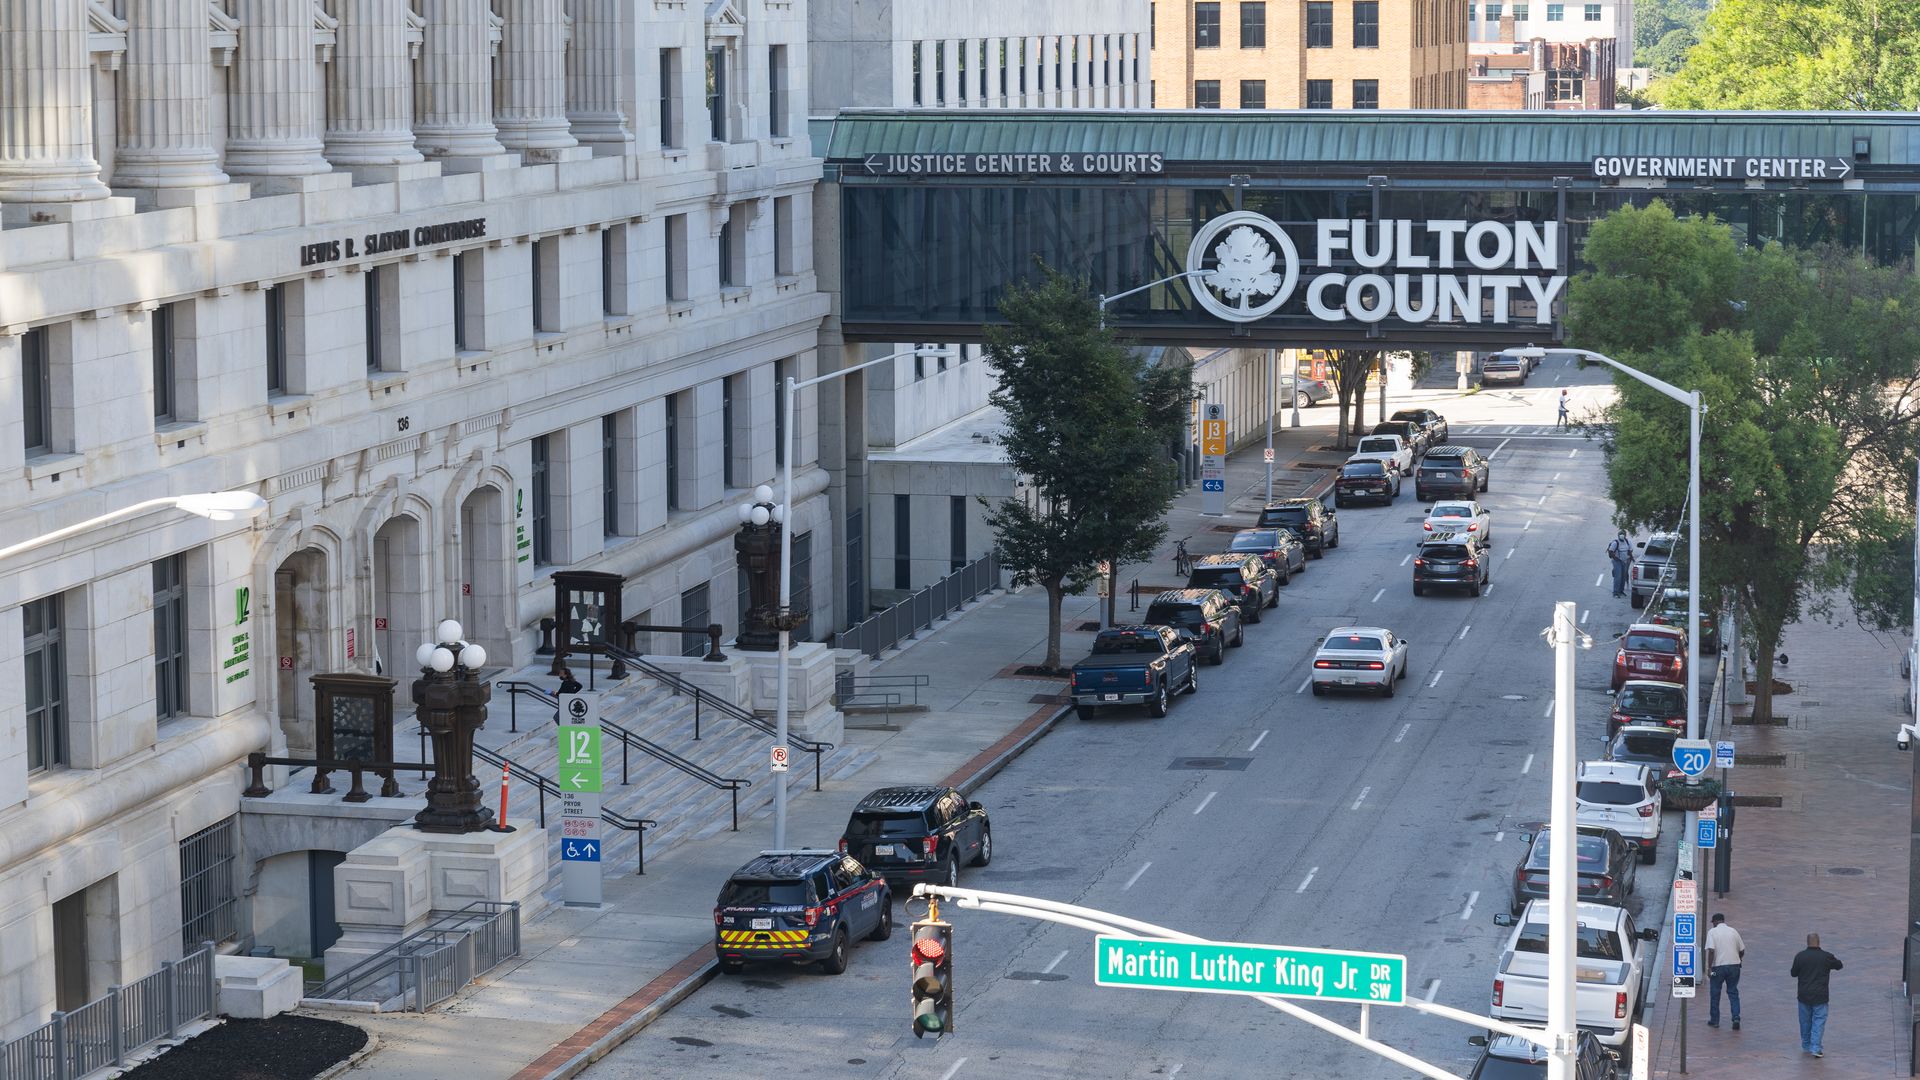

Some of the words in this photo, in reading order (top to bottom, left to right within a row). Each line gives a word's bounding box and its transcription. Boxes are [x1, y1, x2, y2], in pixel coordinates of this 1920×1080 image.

[887, 154, 967, 173] JUSTICE
[975, 154, 1051, 173] CENTER
[1059, 154, 1075, 173] &
[1082, 154, 1163, 173] COURTS
[1594, 157, 1736, 177] GOVERNMENT
[1745, 158, 1826, 177] CENTER
[300, 240, 340, 266] LEWIS
[364, 229, 410, 255] SLATON
[414, 217, 487, 247] COURTHOUSE
[1316, 218, 1558, 270] FULTON
[1306, 272, 1568, 325] COUNTY
[396, 415, 410, 432] 136
[1206, 422, 1221, 440] J3
[566, 730, 590, 764] J2
[1683, 753, 1705, 771] 20
[1107, 946, 1179, 979] Martin
[1190, 951, 1265, 984] Luther
[1275, 956, 1324, 997] King
[1333, 960, 1359, 990] Jr
[1370, 963, 1391, 982] DR
[1369, 982, 1392, 1000] SW
